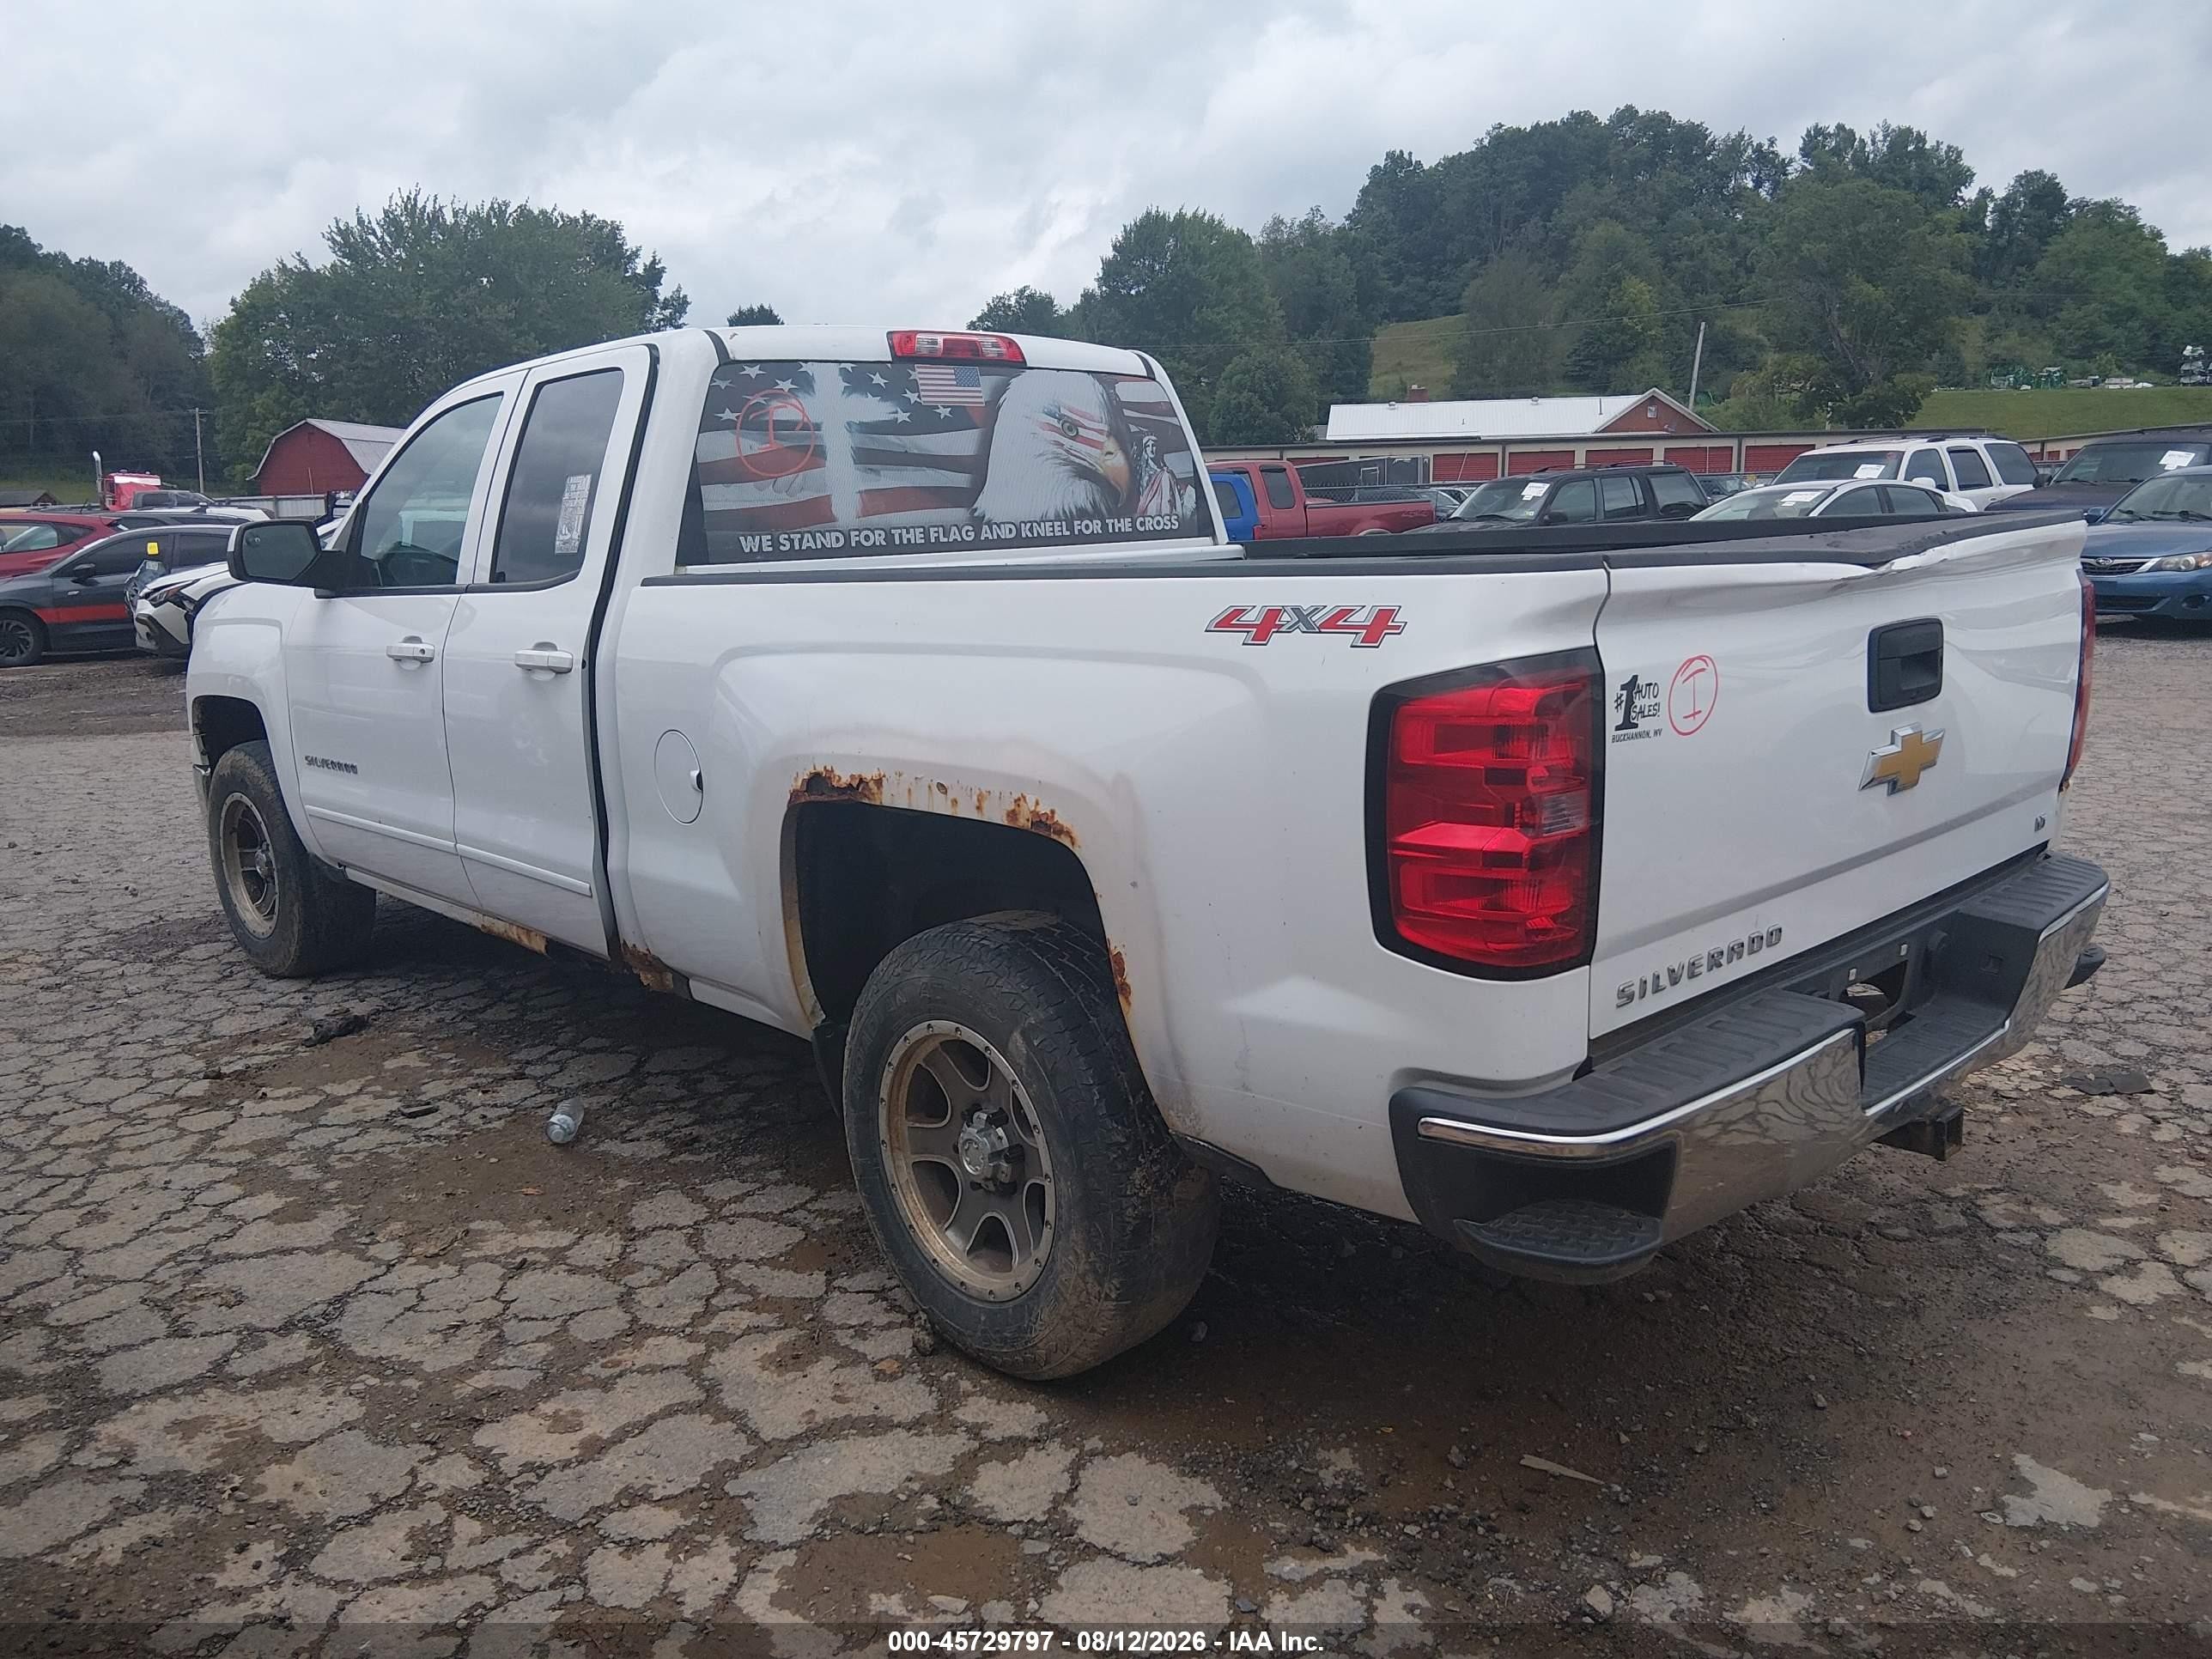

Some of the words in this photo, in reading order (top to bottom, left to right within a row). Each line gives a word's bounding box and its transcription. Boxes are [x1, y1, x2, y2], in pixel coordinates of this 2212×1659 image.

[739, 534, 774, 553] WE
[779, 531, 845, 551] STAND
[850, 529, 887, 547] FOR
[891, 526, 925, 544] THE
[930, 525, 975, 544] FLAG
[980, 523, 1017, 541] AND
[1021, 520, 1071, 538] KNEEL
[1074, 518, 1103, 536] FOR
[1106, 517, 1133, 534] THE
[1136, 515, 1179, 532] CROSS
[1634, 683, 1659, 701] AUTO
[1632, 702, 1661, 721] SALES!
[1653, 727, 1663, 738] WV
[1616, 923, 1783, 1009] SILVERADO
